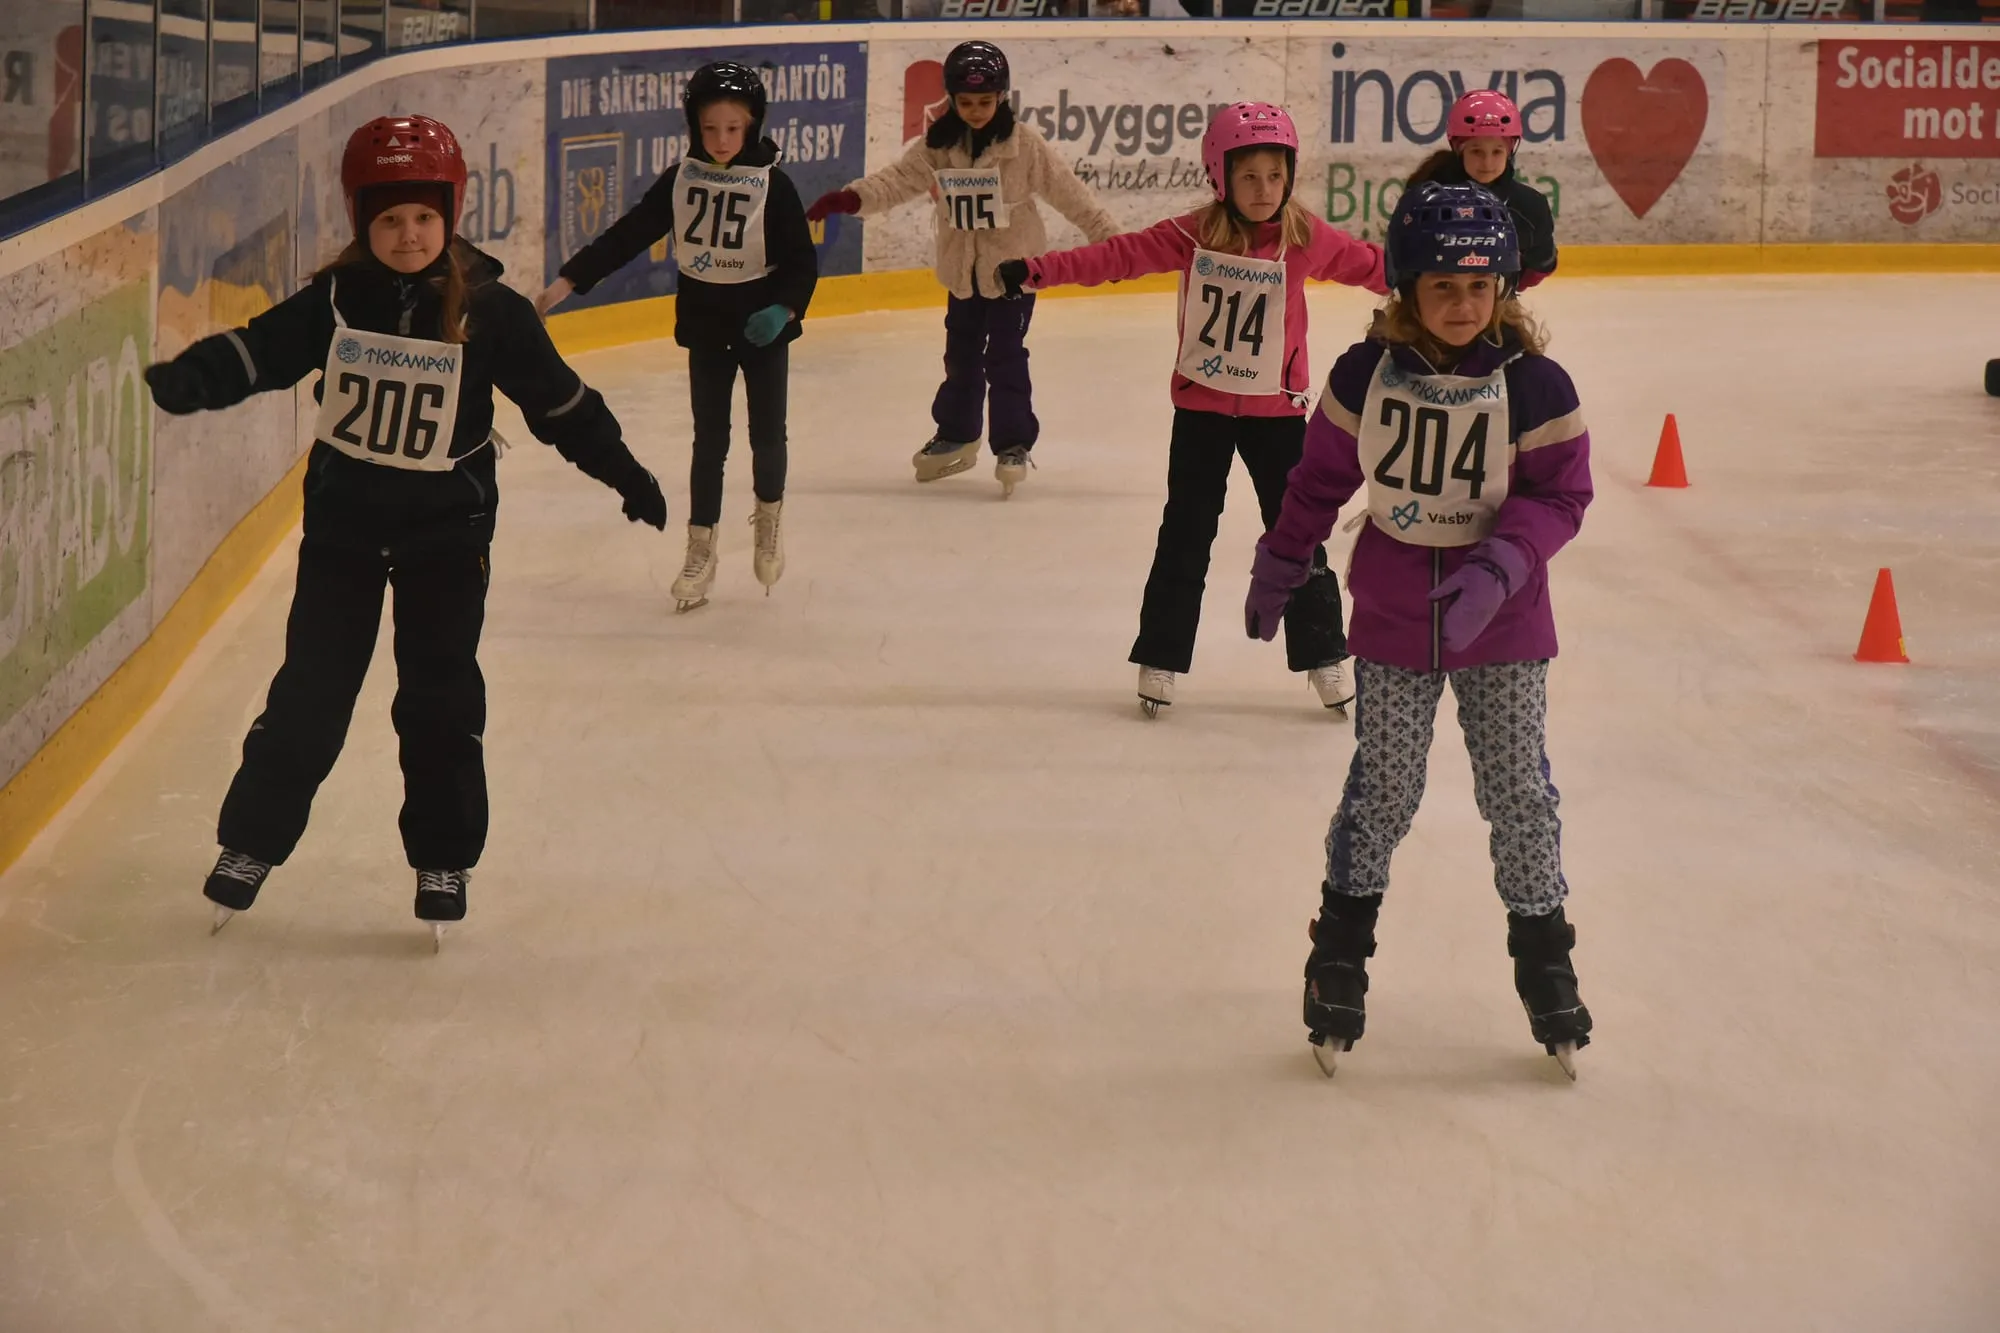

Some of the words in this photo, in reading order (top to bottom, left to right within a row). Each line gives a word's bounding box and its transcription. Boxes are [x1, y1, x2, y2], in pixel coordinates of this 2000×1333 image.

[1696, 0, 1844, 20] BAUER
[562, 78, 591, 119] DIN
[1903, 102, 1983, 139] mot
[771, 118, 845, 163] VÄSBY
[376, 153, 413, 165] Reebok
[1107, 159, 1158, 190] hela
[684, 186, 751, 249] 215
[715, 258, 744, 268] Väsby
[1216, 263, 1282, 284] TIOKAMPEN
[1199, 284, 1267, 356] 214
[365, 347, 455, 374] TIOKAMPEN
[1226, 365, 1259, 379] Väsby
[1409, 379, 1501, 405] TIOKAMPEN
[332, 372, 445, 460] 206
[1374, 397, 1490, 500] 204
[1427, 512, 1474, 525] Väsby
